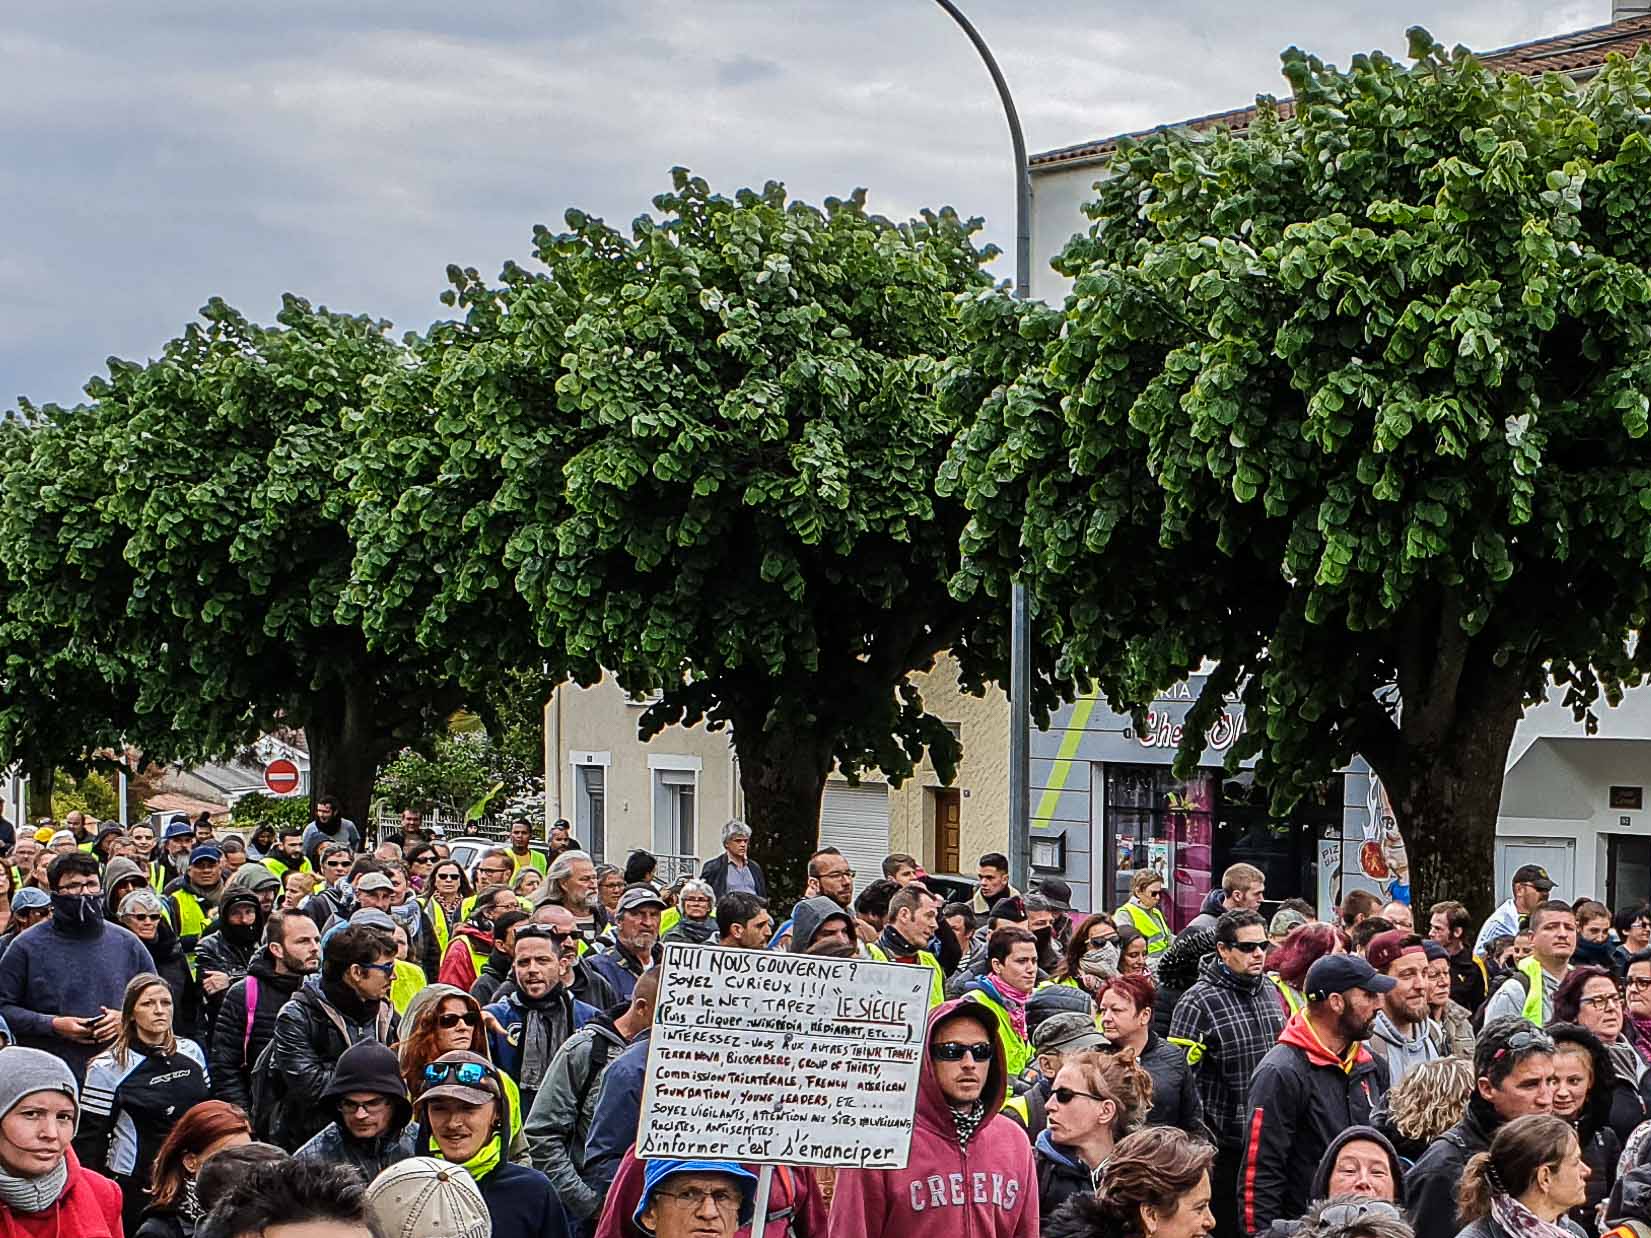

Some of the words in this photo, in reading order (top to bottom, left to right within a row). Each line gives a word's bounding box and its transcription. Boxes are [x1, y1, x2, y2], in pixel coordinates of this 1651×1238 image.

[669, 946, 702, 971] QUI
[710, 952, 751, 975] NOUS
[755, 955, 843, 981] GOUVERNE
[667, 972, 713, 988] SOYEZ
[664, 990, 694, 1006] SUR
[811, 1042, 848, 1057] AUTRES
[651, 1102, 688, 1117] SOYEZ
[910, 1172, 1019, 1212] CREEKS
